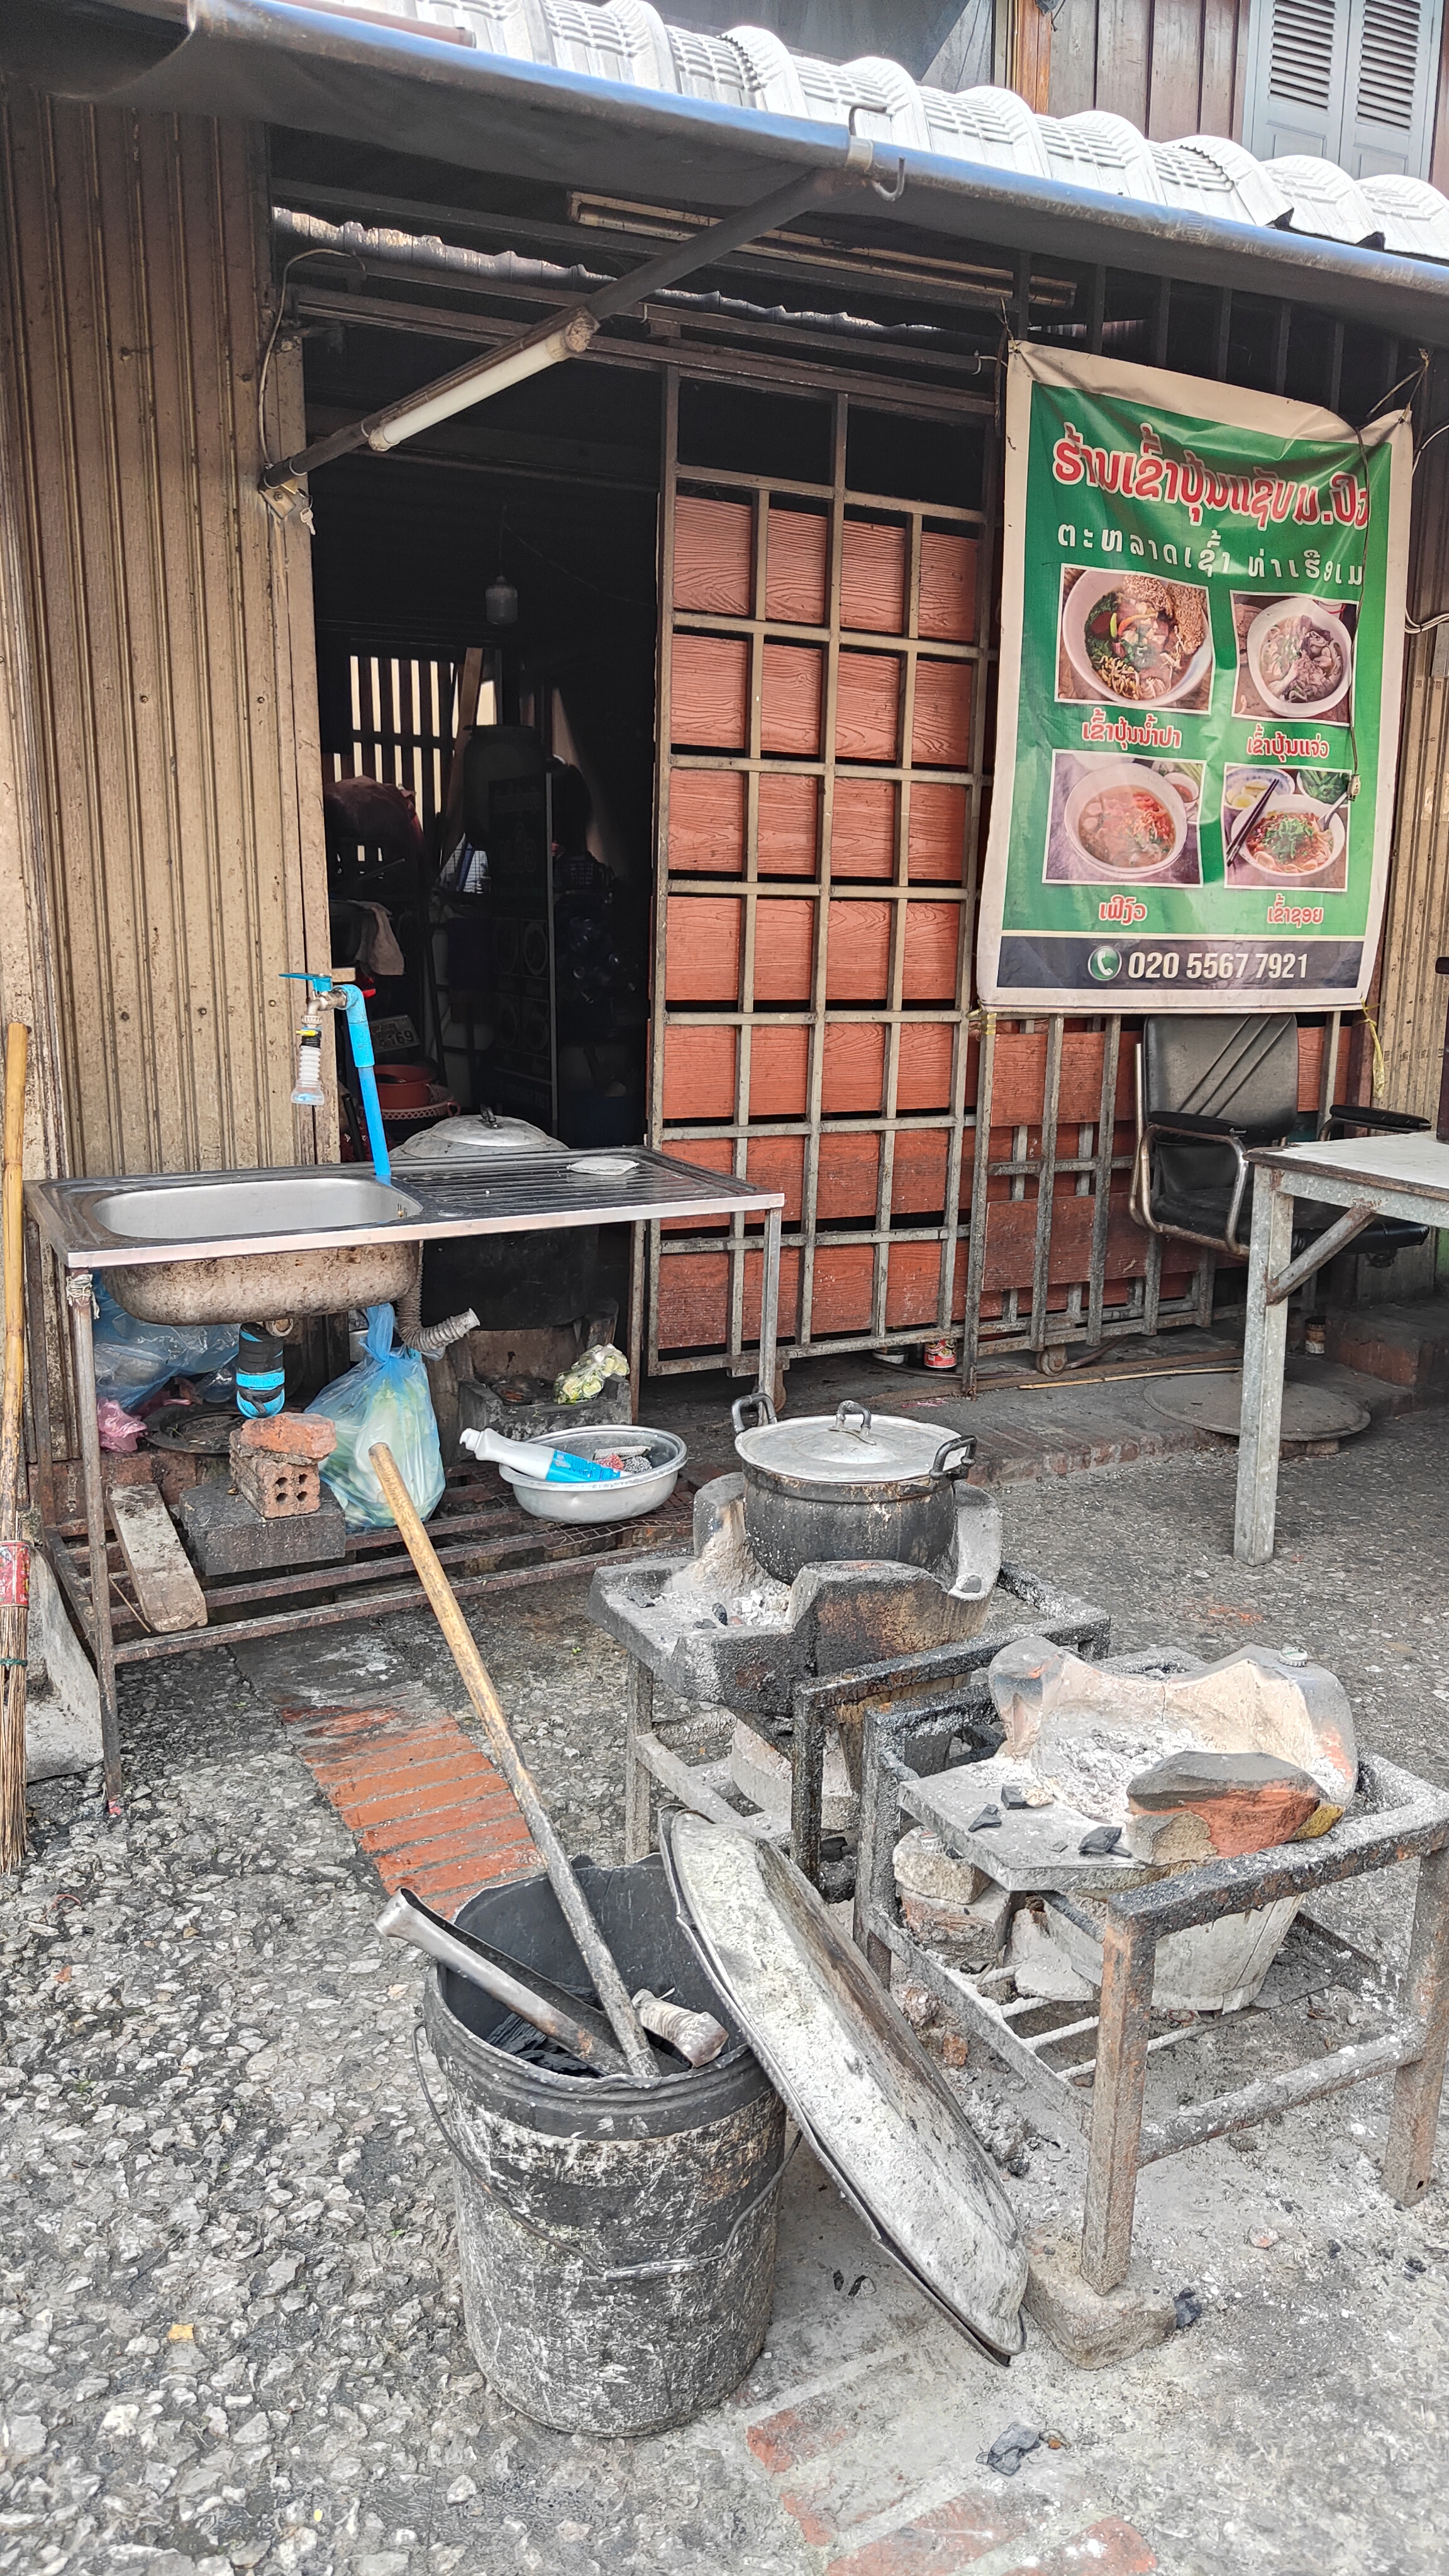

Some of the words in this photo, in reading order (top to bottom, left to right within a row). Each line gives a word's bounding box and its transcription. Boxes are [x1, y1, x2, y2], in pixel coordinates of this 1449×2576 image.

[1267, 892, 1324, 928] ເຂົ້າຊອຍ
[1128, 952, 1180, 979] 020
[1186, 953, 1249, 979] 5567
[1255, 953, 1307, 979] 7921
